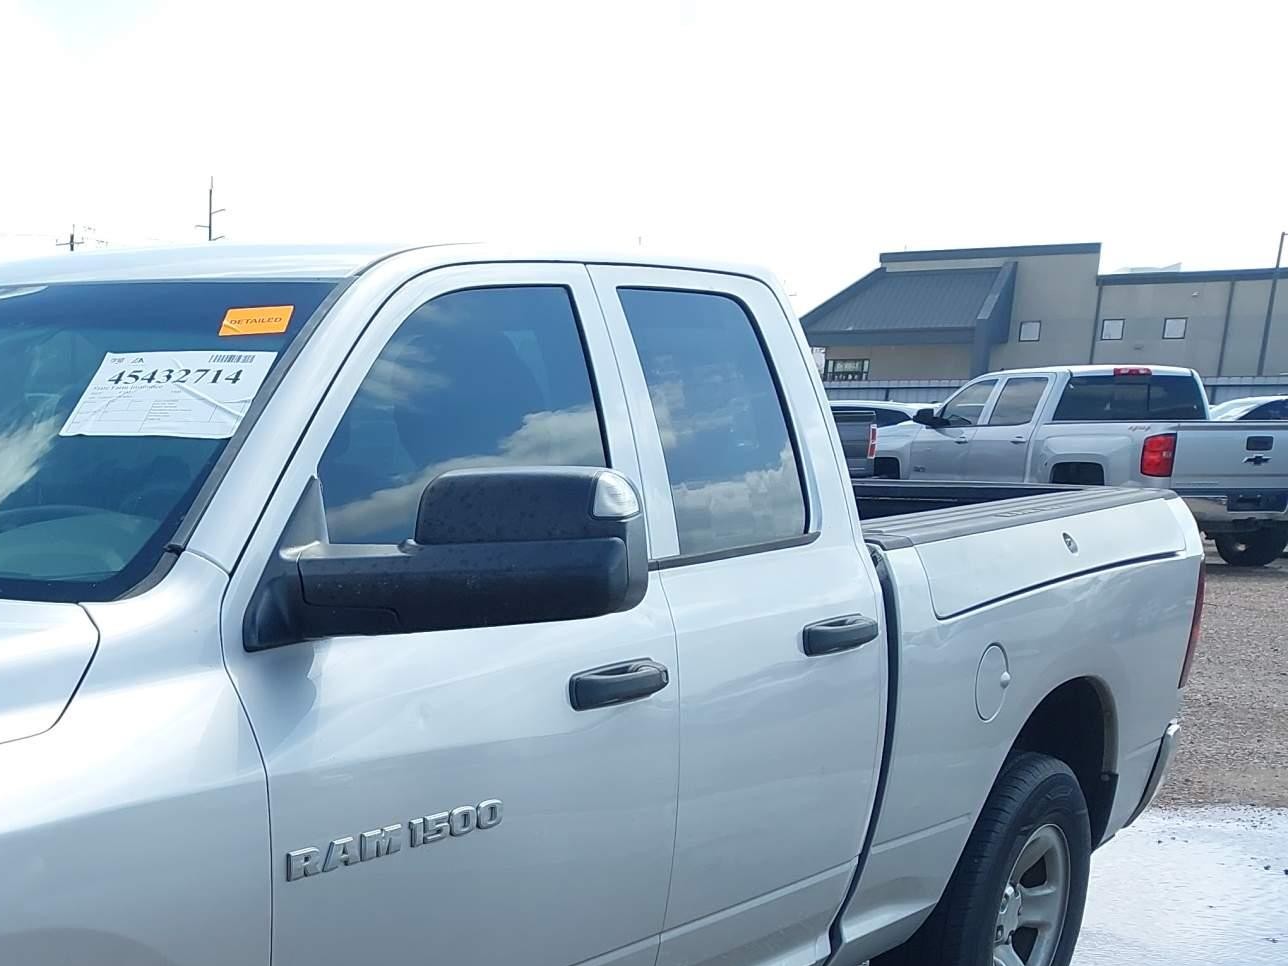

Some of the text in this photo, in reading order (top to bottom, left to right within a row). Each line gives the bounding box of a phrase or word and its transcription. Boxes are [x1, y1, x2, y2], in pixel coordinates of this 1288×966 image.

[229, 317, 283, 325] DETAILED
[108, 369, 243, 384] 45432714
[287, 799, 504, 882] RAM 1500
